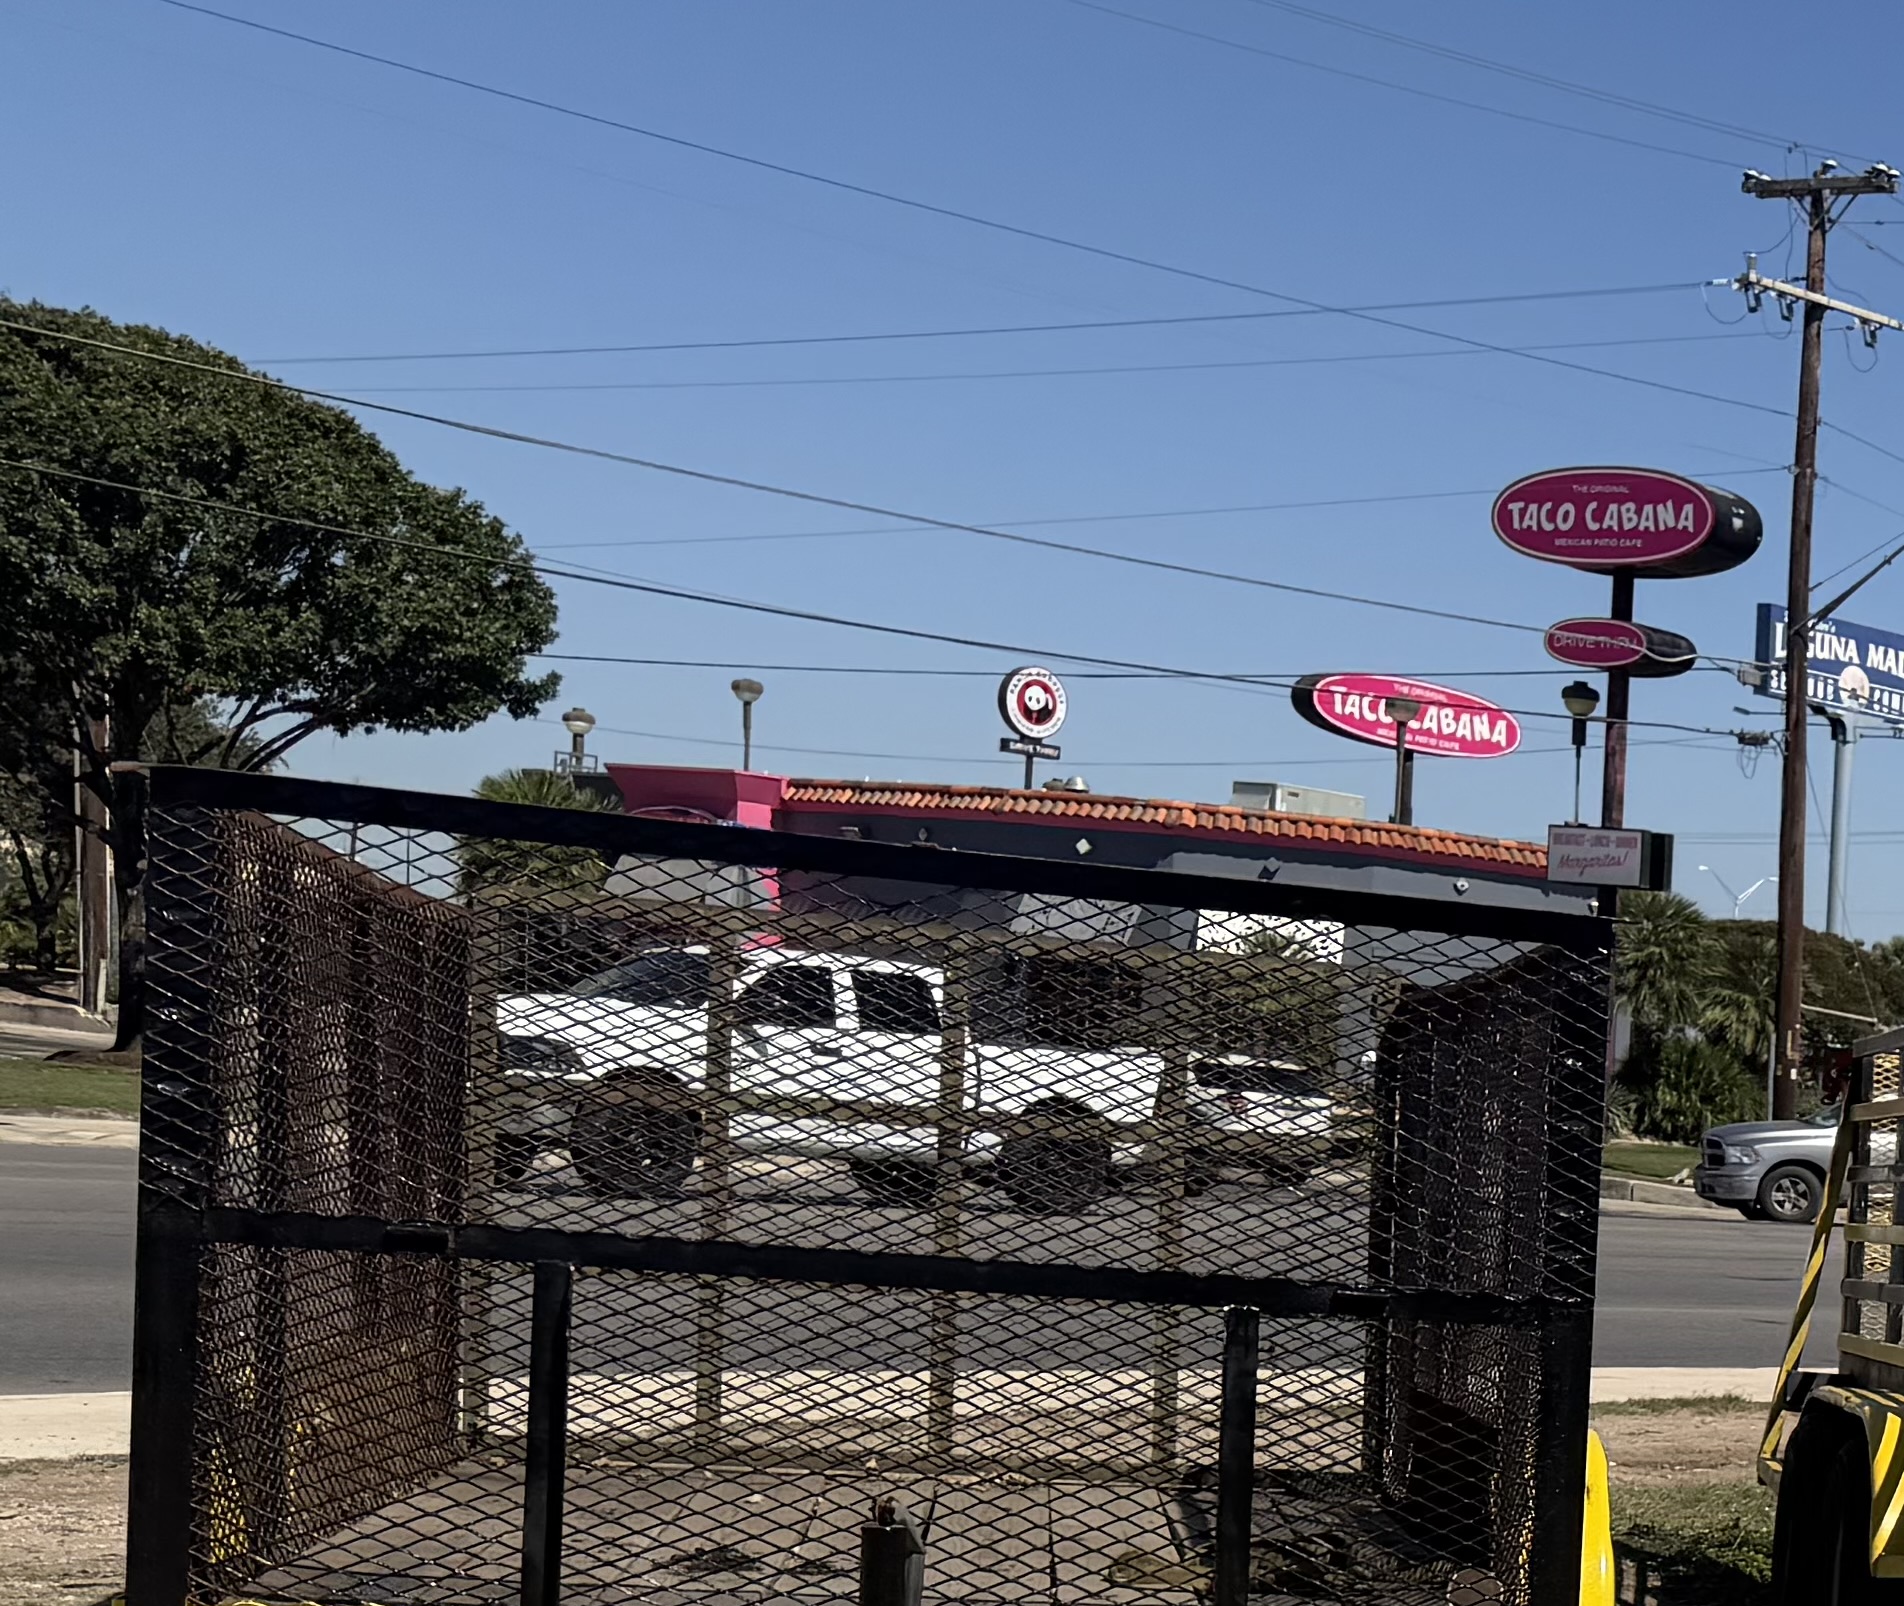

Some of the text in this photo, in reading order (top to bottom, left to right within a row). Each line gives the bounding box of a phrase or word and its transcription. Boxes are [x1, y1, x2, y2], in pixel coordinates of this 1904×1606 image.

[1507, 499, 1694, 534] TACO CABANA
[1553, 634, 1596, 649] DRIVE
